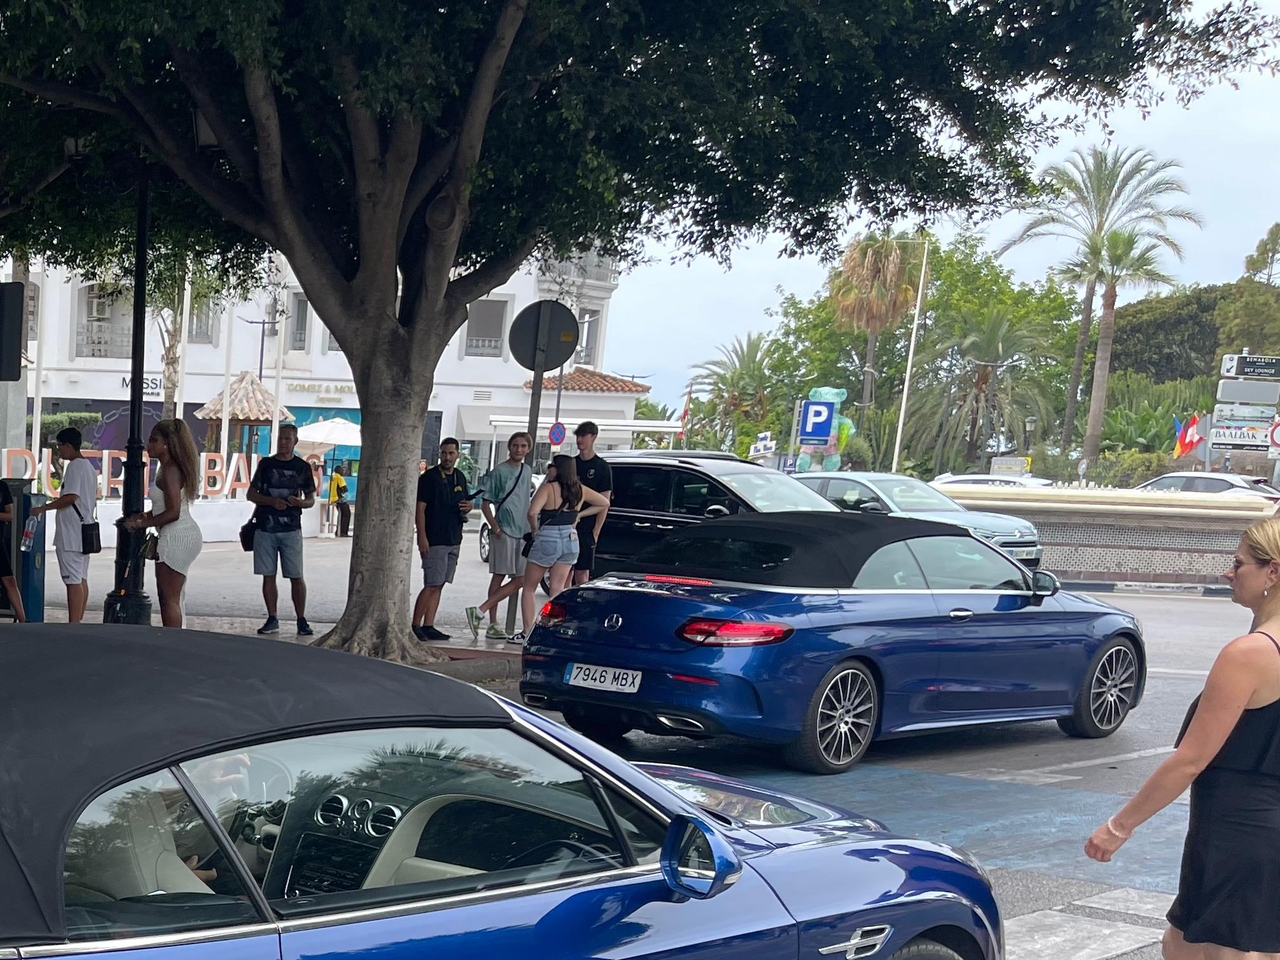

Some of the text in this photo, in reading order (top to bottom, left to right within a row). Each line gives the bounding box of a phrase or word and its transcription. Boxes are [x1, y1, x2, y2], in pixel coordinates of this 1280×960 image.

[805, 404, 829, 433] P
[787, 458, 793, 466] P
[573, 666, 607, 684] 7946
[611, 670, 640, 689] MBX
